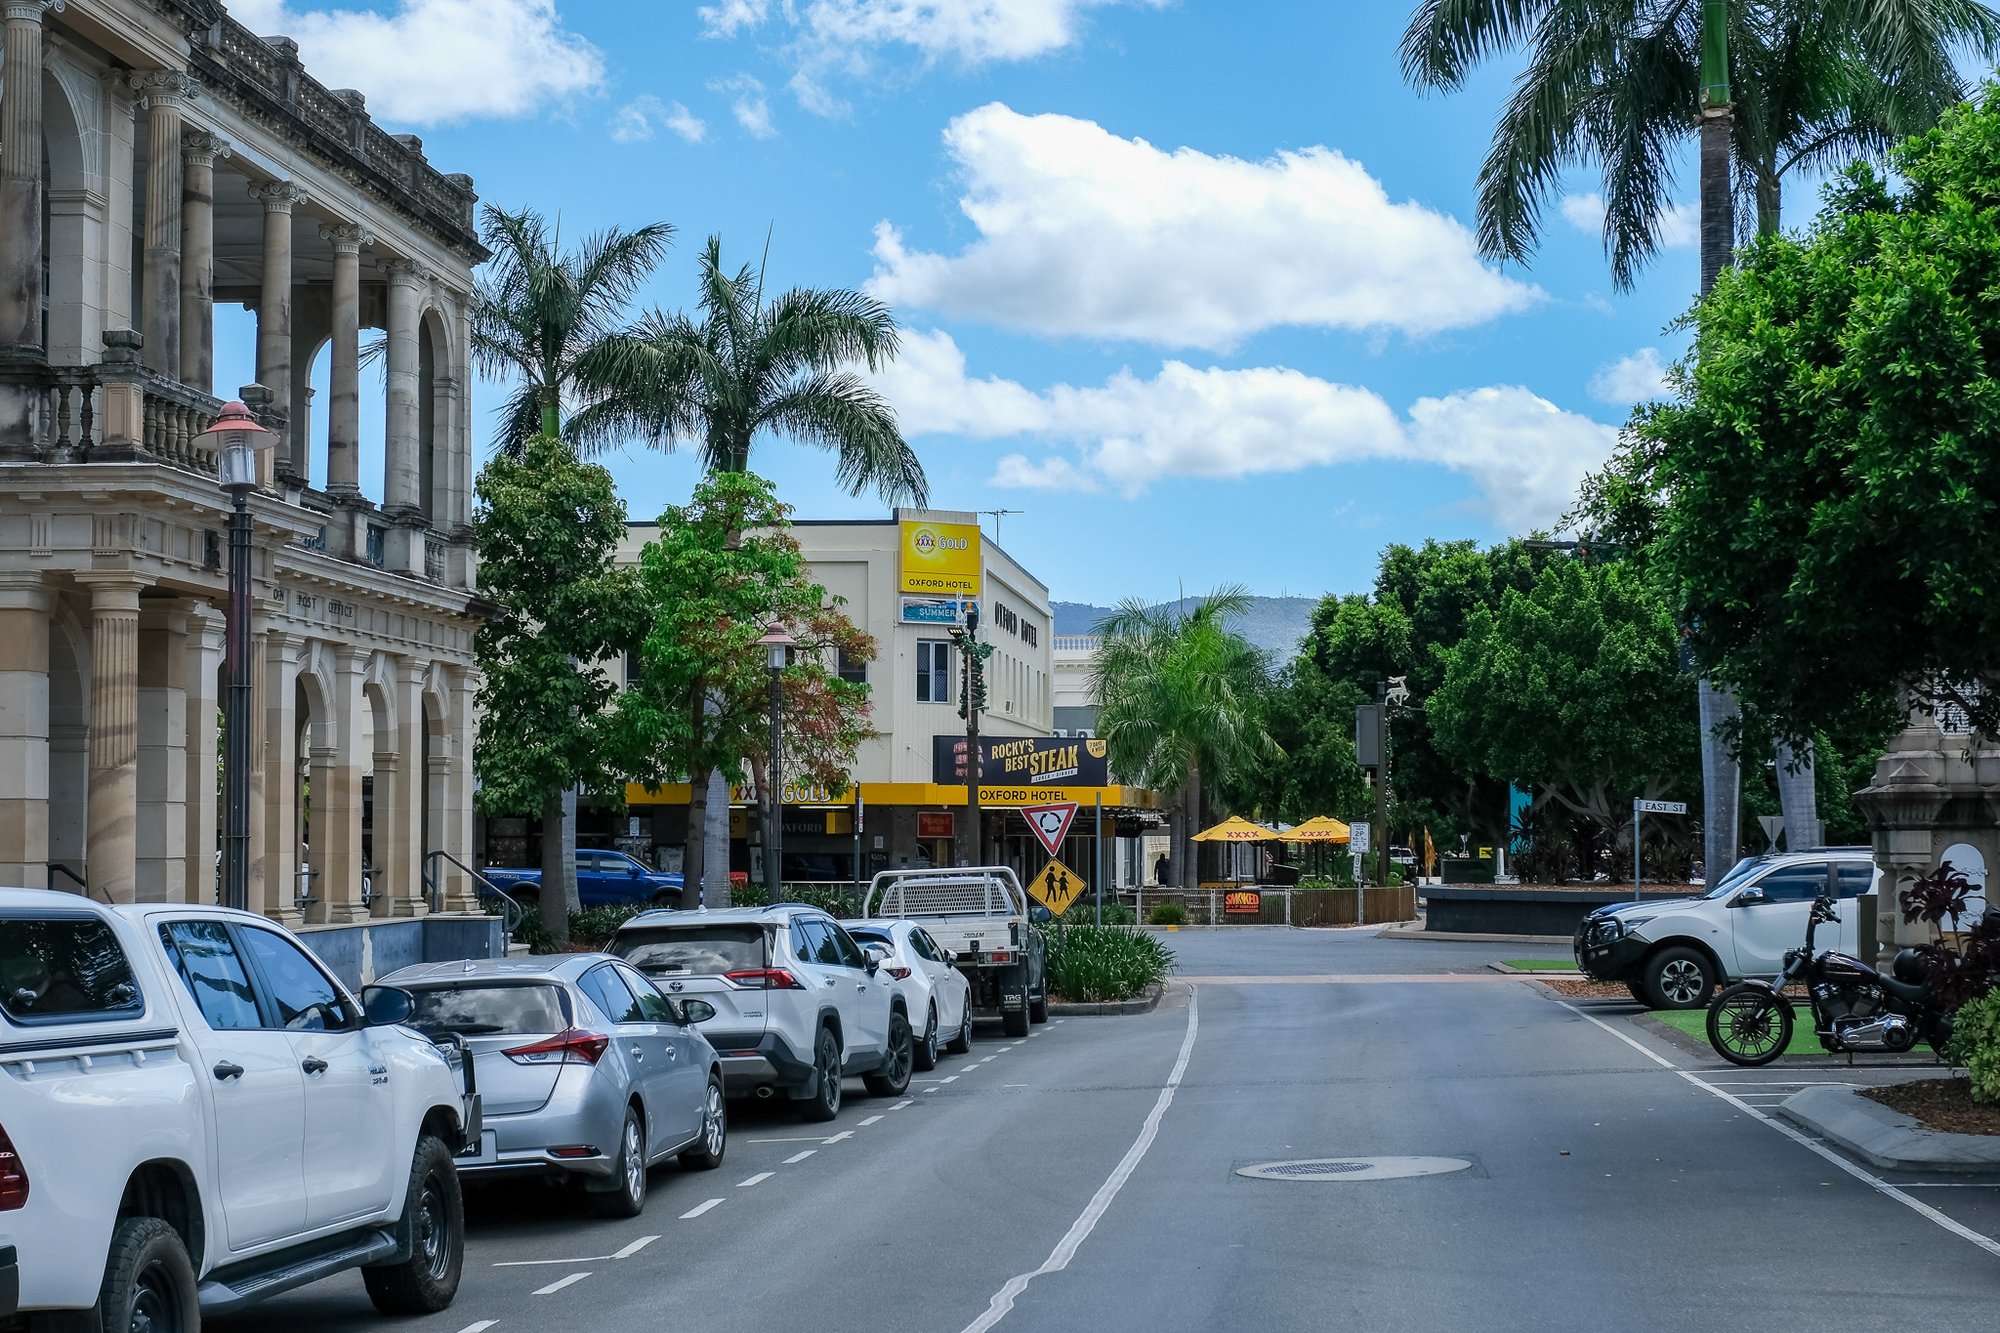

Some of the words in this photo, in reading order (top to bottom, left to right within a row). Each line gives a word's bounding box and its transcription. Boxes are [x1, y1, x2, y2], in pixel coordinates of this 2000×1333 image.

[915, 538, 936, 547] XXXX
[938, 536, 968, 550] GOLD
[909, 579, 943, 588] OXFORD
[946, 581, 972, 589] HOTEL
[297, 594, 317, 609] POST
[328, 602, 353, 617] OFFICE
[919, 608, 956, 617] SUMMER
[994, 601, 1018, 637] OXFORD
[1021, 618, 1037, 648] HOTEL
[991, 739, 1034, 760] ROCKY'S
[1005, 755, 1029, 772] BEST
[1029, 745, 1079, 775] STEAK
[979, 790, 1027, 801] OXFORD
[1031, 791, 1067, 800] HOTEL
[1645, 802, 1668, 811] EAST
[1673, 804, 1684, 812] ST
[1225, 892, 1259, 905] SMOKED
